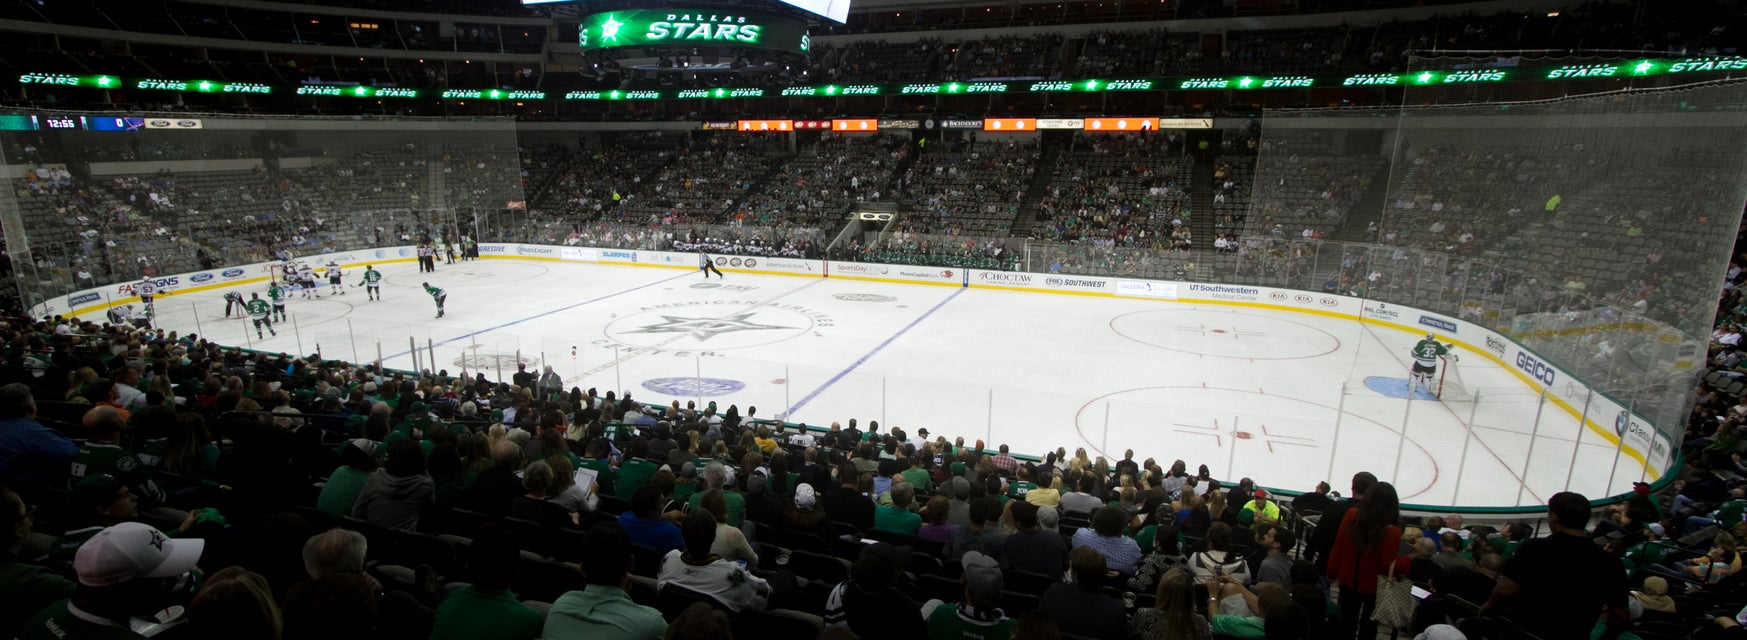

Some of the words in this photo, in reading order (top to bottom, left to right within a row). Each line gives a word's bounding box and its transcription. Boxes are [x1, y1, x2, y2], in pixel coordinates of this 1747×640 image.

[666, 14, 746, 23] DALLAS
[646, 22, 761, 42] STARS
[1669, 60, 1747, 72] STARS
[1548, 67, 1618, 78] STARS
[20, 75, 78, 85] STARS
[1343, 76, 1399, 86] STARS
[1443, 72, 1504, 83] STARS
[138, 81, 186, 90] STARS
[1030, 83, 1072, 91] STARS
[1106, 82, 1151, 90] STARS
[1181, 80, 1228, 88] STARS
[1262, 79, 1313, 87] STARS
[224, 85, 270, 93] STARS
[47, 119, 74, 128] 12:55
[116, 118, 123, 127] 0
[985, 272, 1032, 282] CHOCTAW
[1064, 279, 1106, 288] SOUTHWEST
[253, 304, 260, 312] 2
[640, 300, 762, 311] AMERICAN
[592, 339, 716, 356] CENTER
[1423, 347, 1435, 357] 32
[1516, 351, 1555, 387] GEICO
